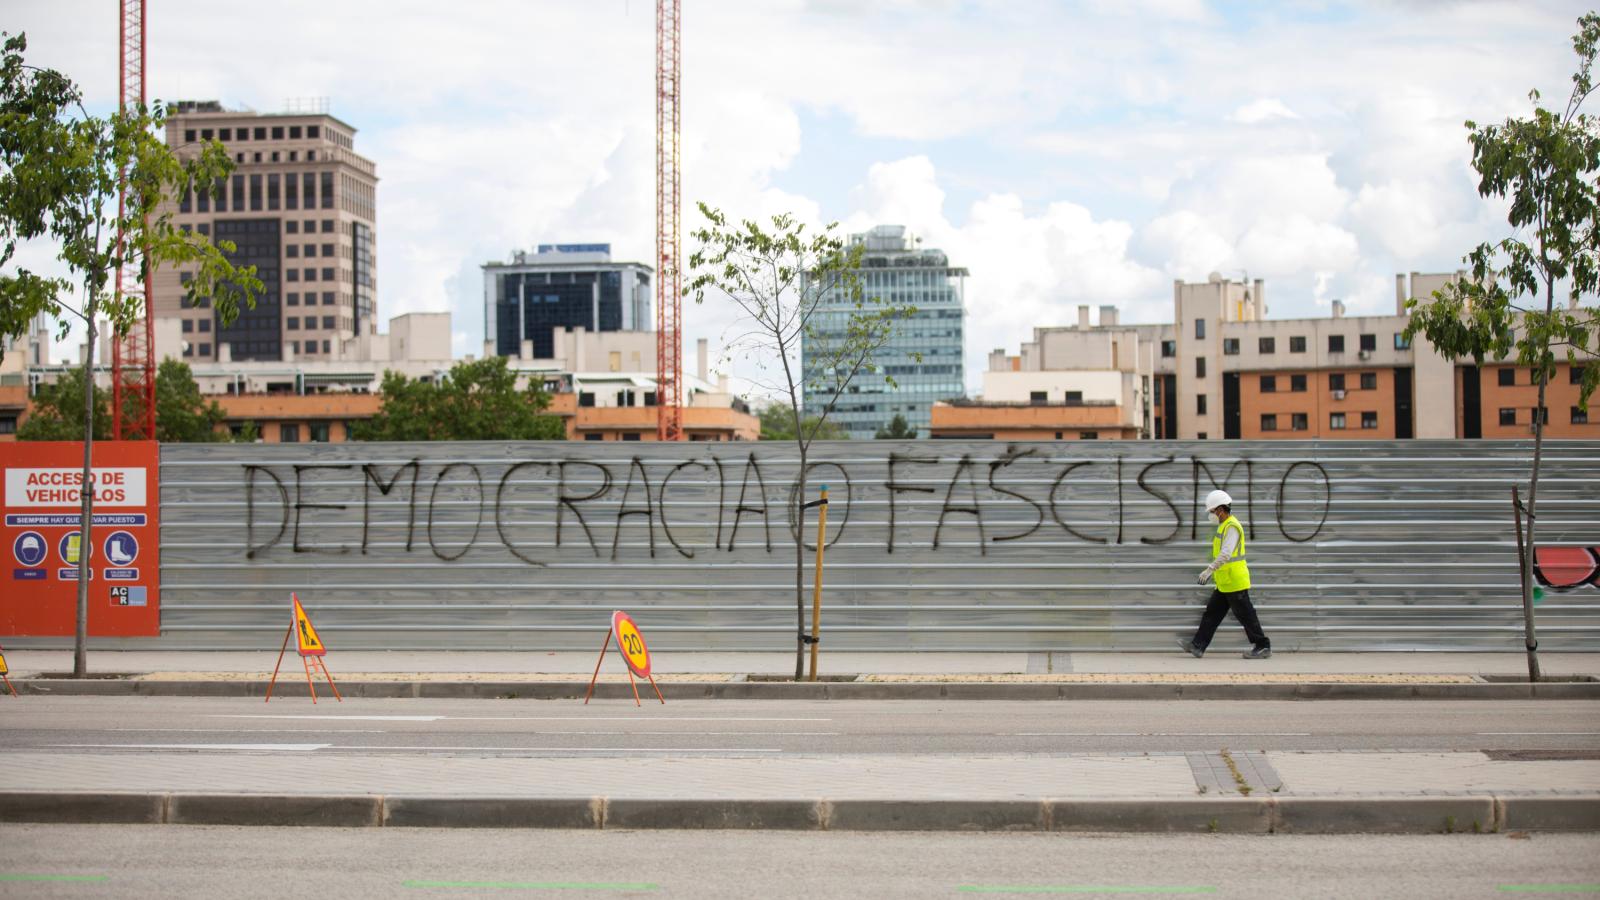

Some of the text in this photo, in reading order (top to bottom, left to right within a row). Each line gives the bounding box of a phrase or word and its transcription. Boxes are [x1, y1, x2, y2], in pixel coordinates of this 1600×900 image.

[101, 472, 125, 485] DE
[26, 489, 126, 502] VEHICLOS
[241, 452, 772, 567] DEMOCRACIA
[884, 446, 1331, 556] FASCISMO
[65, 516, 80, 524] QUE
[108, 516, 136, 524] PUESTO
[623, 633, 642, 655] 20
